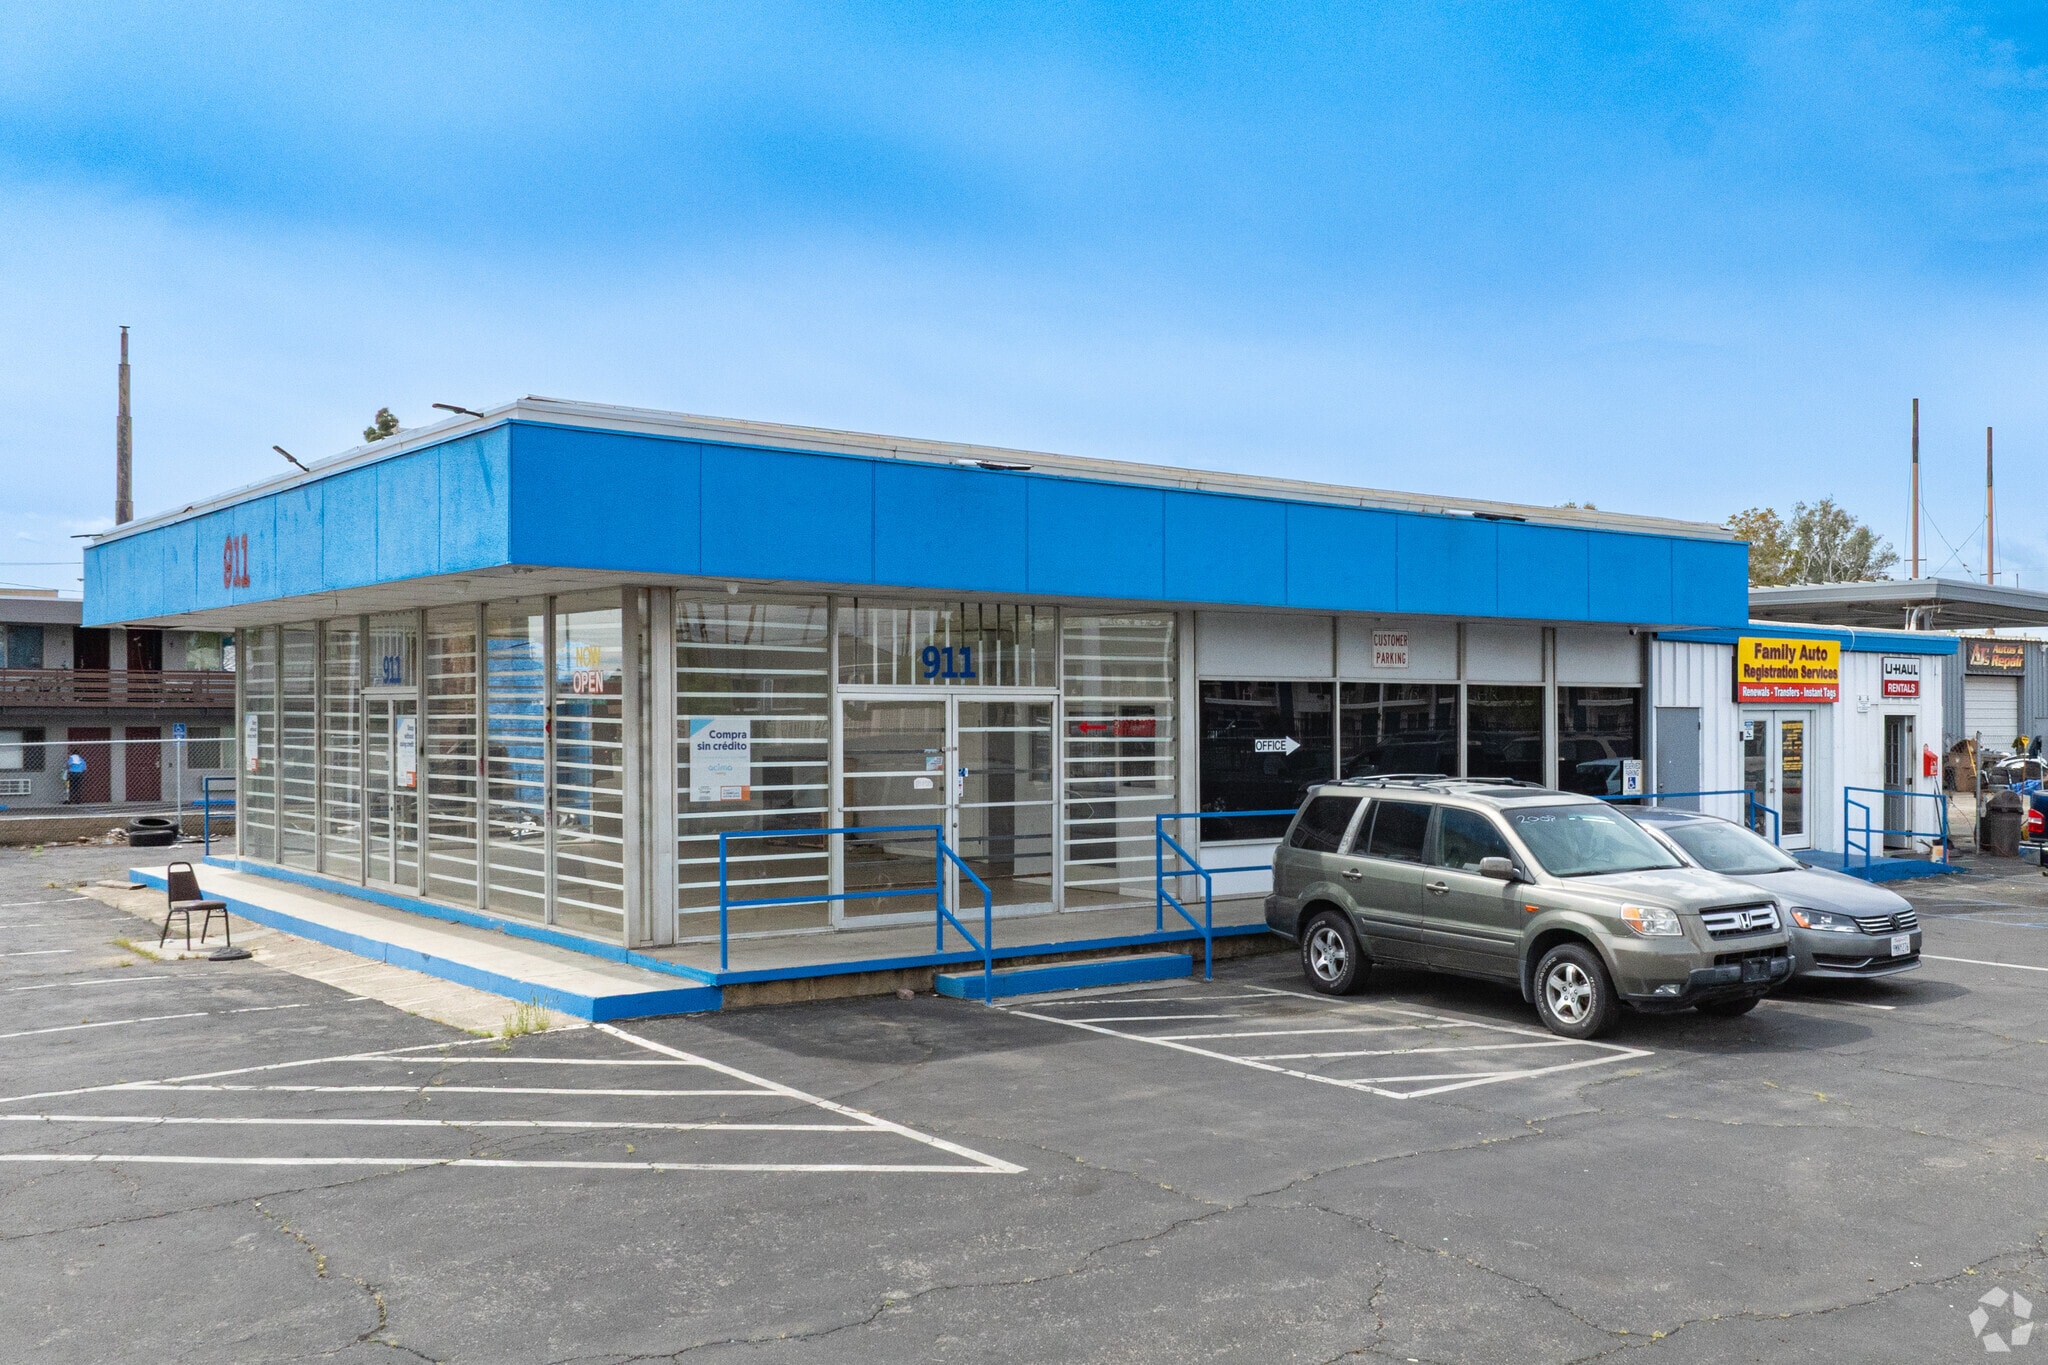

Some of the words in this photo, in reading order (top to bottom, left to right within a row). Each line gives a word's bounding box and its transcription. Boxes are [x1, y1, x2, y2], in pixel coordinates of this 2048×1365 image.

[1373, 634, 1408, 647] CUSTOMER
[1754, 642, 1796, 664] Family
[1799, 644, 1828, 661] Auto
[1992, 644, 2016, 655] Autos
[575, 646, 601, 668] NOW
[922, 645, 976, 679] 911
[1376, 652, 1407, 665] PARKING
[1991, 654, 2024, 670] Repair
[383, 655, 402, 684] 911
[1743, 663, 1798, 681] Registration
[1801, 665, 1838, 680] Services
[1885, 663, 1918, 675] U-HAUL
[573, 670, 604, 694] OPEN
[1887, 683, 1916, 694] RENTALS
[1742, 686, 1770, 697] Renewals
[1774, 686, 1800, 697] Transfers
[1803, 687, 1823, 698] Instant
[1823, 687, 1837, 700] Tags
[709, 730, 747, 741] Compra
[697, 741, 711, 751] sin
[713, 741, 747, 751] crédito
[1255, 740, 1287, 751] OFFICE
[708, 763, 733, 771] acima
